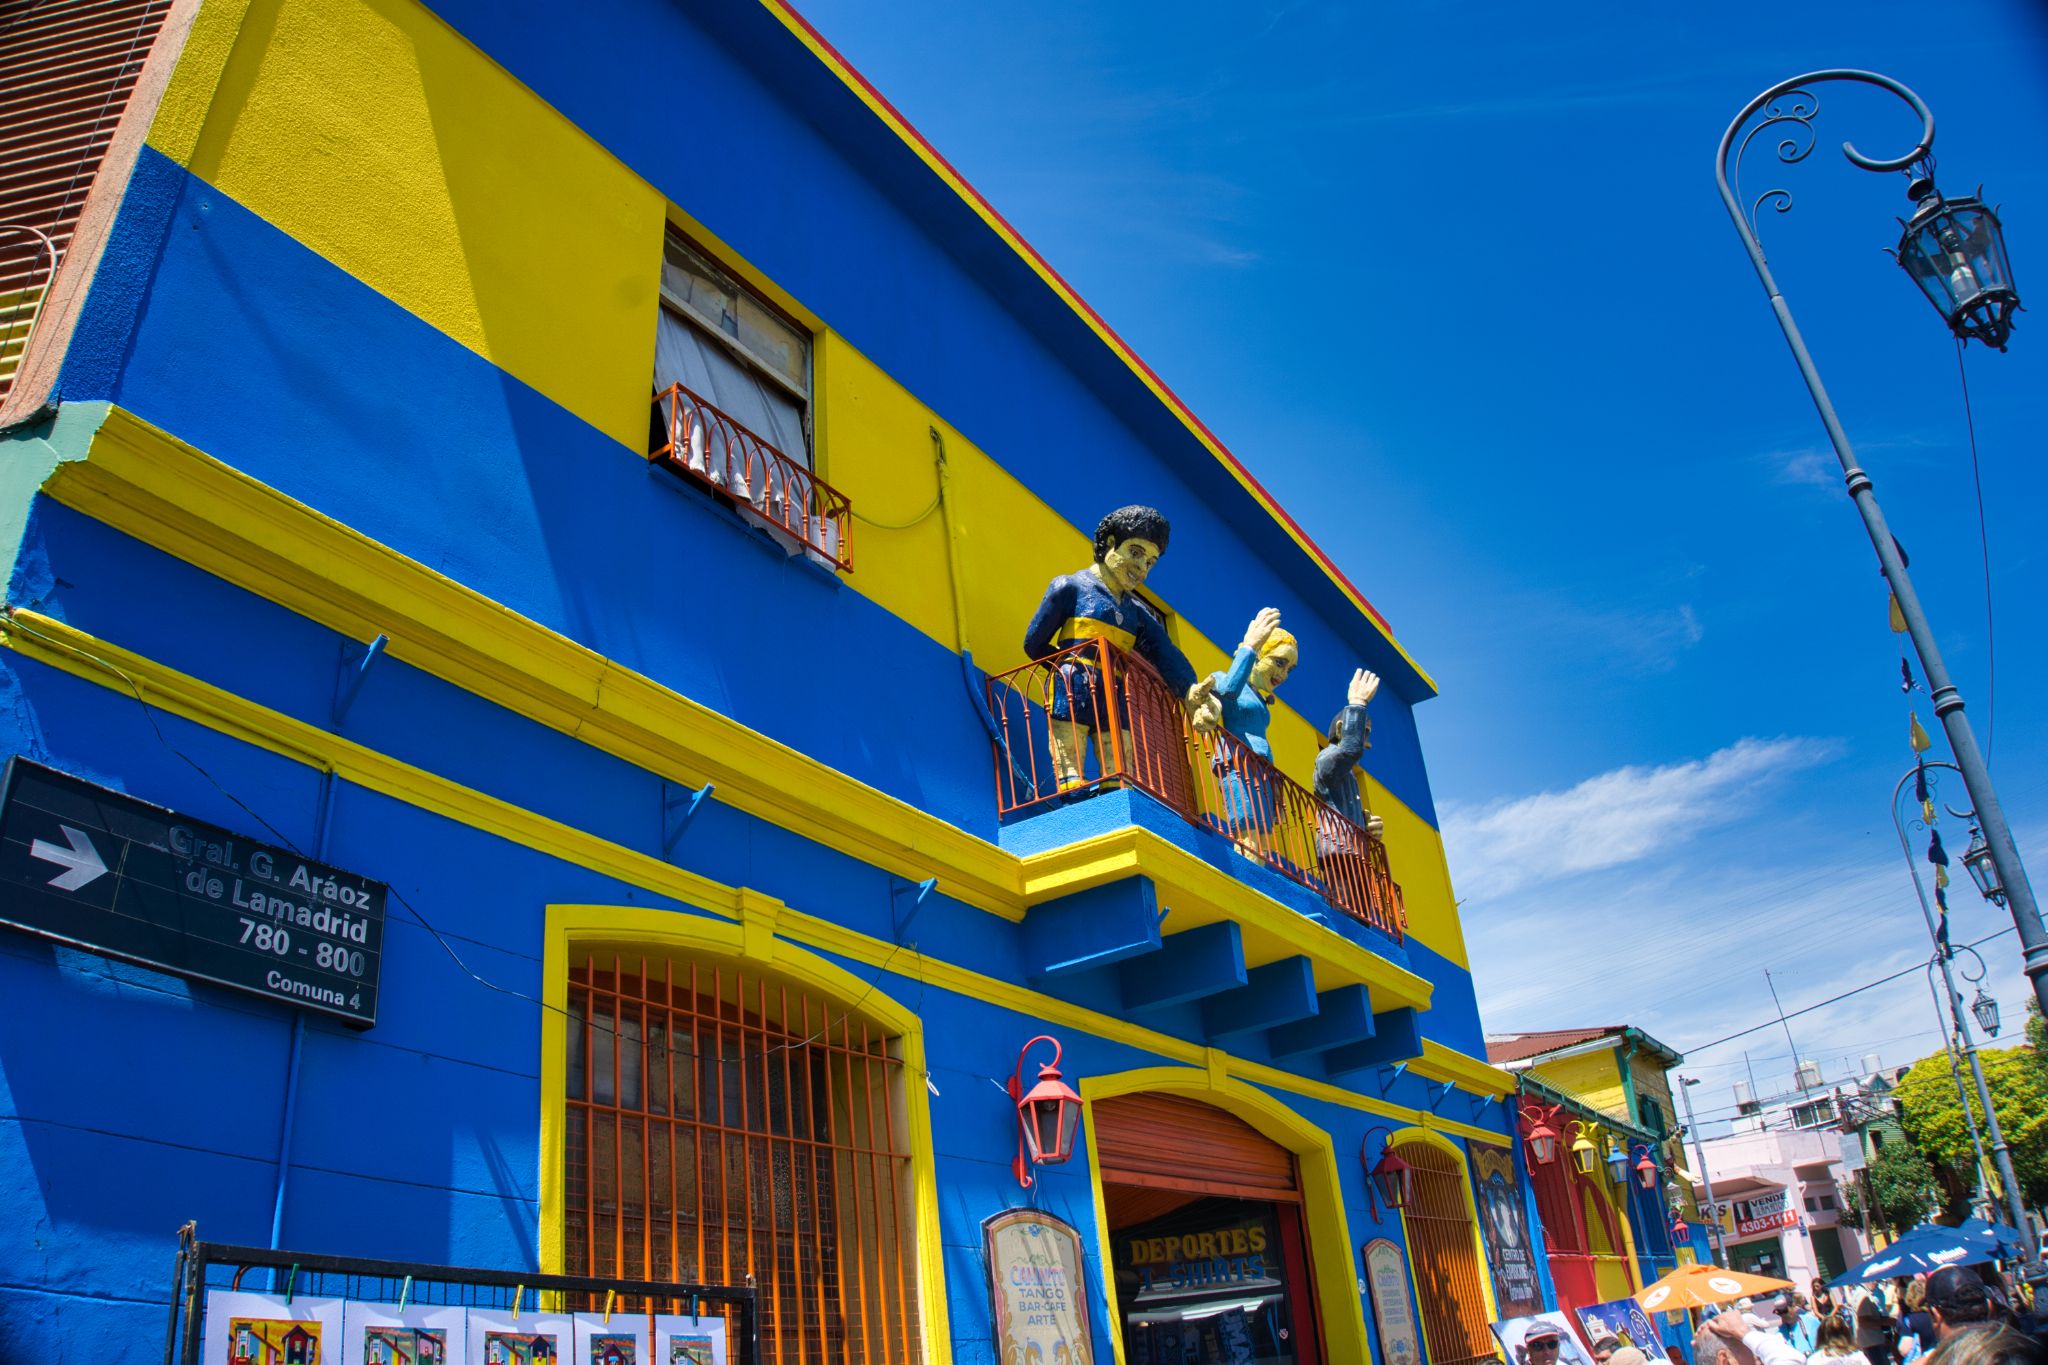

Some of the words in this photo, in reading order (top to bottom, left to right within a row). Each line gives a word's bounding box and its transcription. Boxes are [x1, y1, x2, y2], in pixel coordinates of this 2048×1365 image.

[168, 824, 239, 870] Gral.
[250, 851, 280, 882] G.
[289, 864, 371, 911] Aráoz
[186, 867, 224, 899] de
[232, 879, 368, 944] Lamadrid
[239, 917, 290, 955] 780
[315, 942, 365, 977] 800
[266, 970, 345, 1007] Comuna
[350, 993, 361, 1010] 4
[1750, 1192, 1786, 1208] VENDE
[1129, 1226, 1267, 1265] DEPORTES
[1018, 1288, 1064, 1299] TANGO
[1027, 1314, 1056, 1326] ARTE
